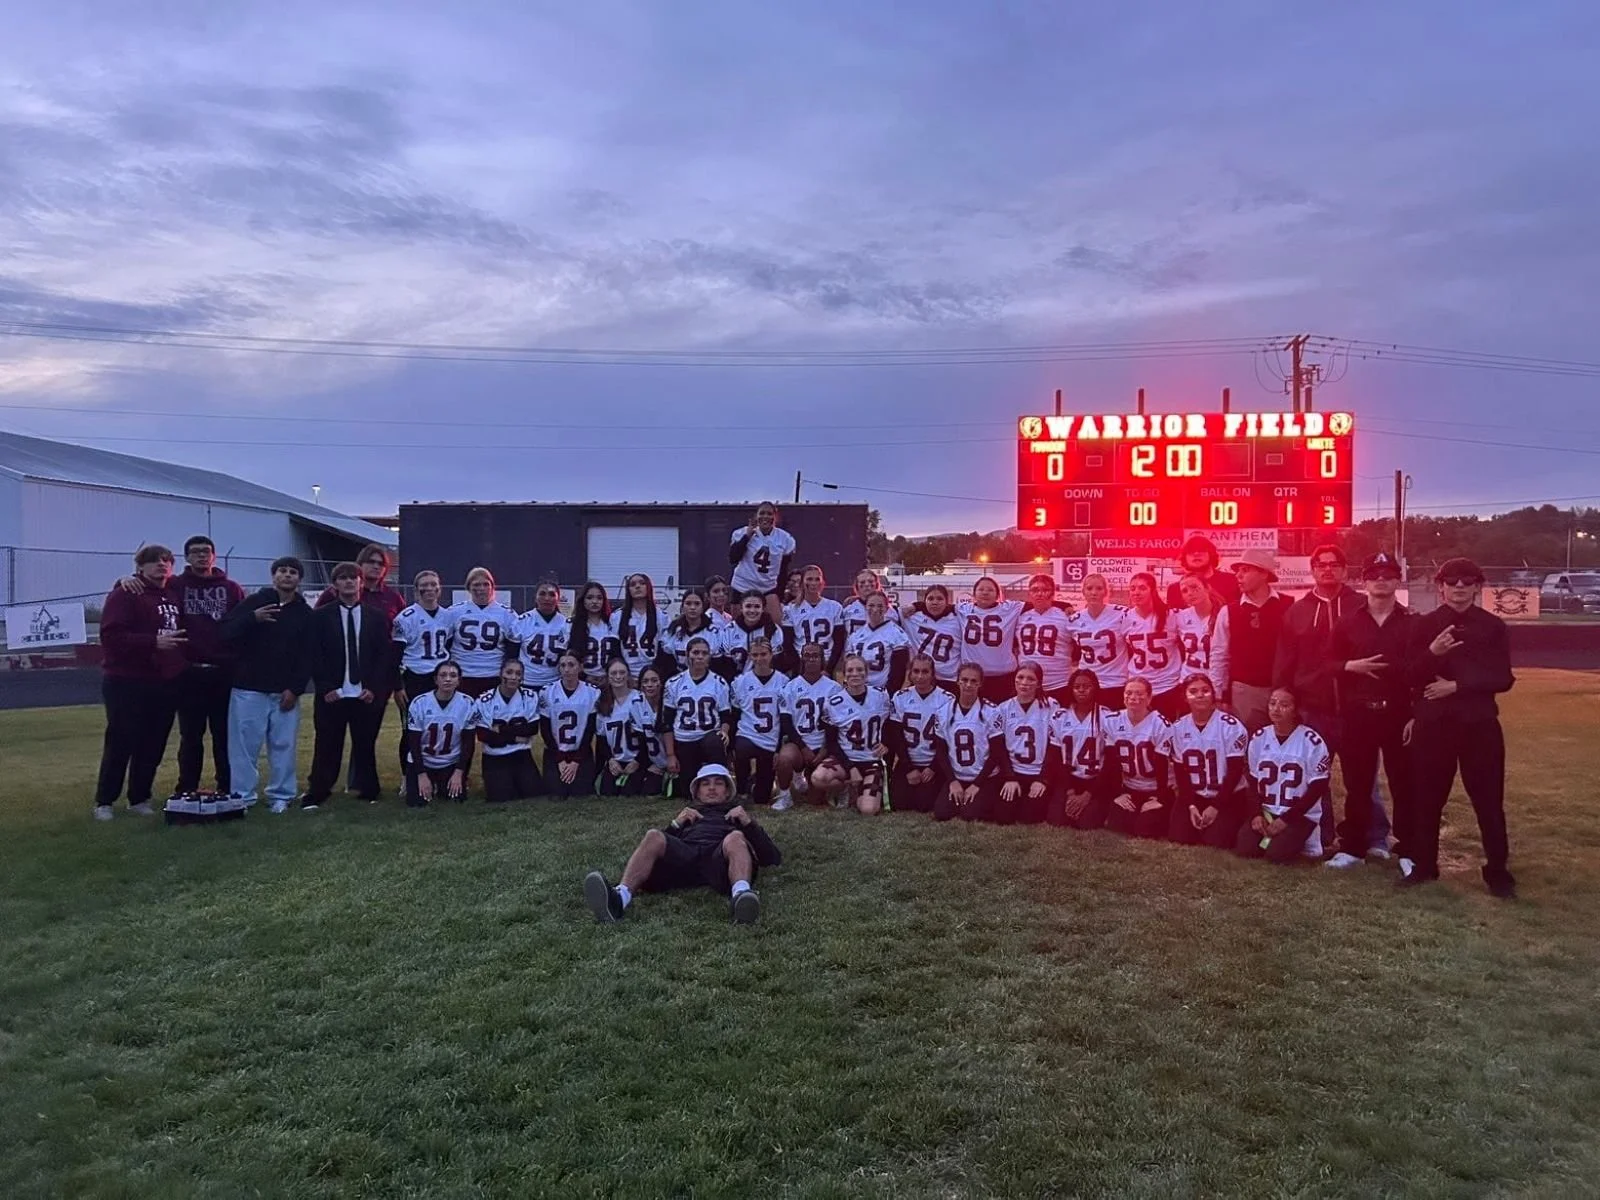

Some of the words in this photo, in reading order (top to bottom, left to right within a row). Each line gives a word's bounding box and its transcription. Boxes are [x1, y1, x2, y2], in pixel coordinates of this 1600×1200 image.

[1045, 414, 1206, 439] WARRIOR
[1224, 413, 1323, 437] FIELD
[1047, 453, 1064, 481] 0
[1320, 450, 1337, 478] 0
[1064, 488, 1103, 499] DOWN
[1200, 487, 1229, 497] BALL
[1232, 487, 1250, 497] ON
[1274, 487, 1298, 497] QTR
[1035, 508, 1047, 526] 3
[1130, 502, 1157, 525] 00
[1210, 501, 1238, 525] 00
[1323, 506, 1335, 524] 3
[1095, 539, 1136, 549] WELLS
[1140, 538, 1180, 549] FARGO
[1210, 531, 1274, 541] ANTHEM
[753, 545, 770, 573] 4
[1091, 558, 1138, 566] COLDWELL
[421, 630, 447, 660] 10
[459, 620, 500, 651] 59
[622, 625, 655, 658] 44
[801, 618, 830, 650] 12
[918, 626, 954, 662] 70
[964, 615, 1002, 647] 66
[1020, 623, 1057, 656] 88
[1078, 629, 1116, 664] 53
[527, 634, 566, 667] 45
[1128, 632, 1168, 669] 55
[1184, 632, 1210, 669] 21
[558, 711, 577, 745] 2
[678, 696, 717, 731] 20
[753, 697, 773, 733] 5
[796, 696, 825, 733] 31
[423, 722, 453, 755] 11
[848, 715, 882, 751] 40
[903, 712, 936, 751] 54
[954, 729, 975, 766] 8
[1015, 726, 1036, 764] 3
[1063, 735, 1100, 775] 14
[1182, 749, 1218, 791] 81
[1258, 760, 1304, 807] 22
